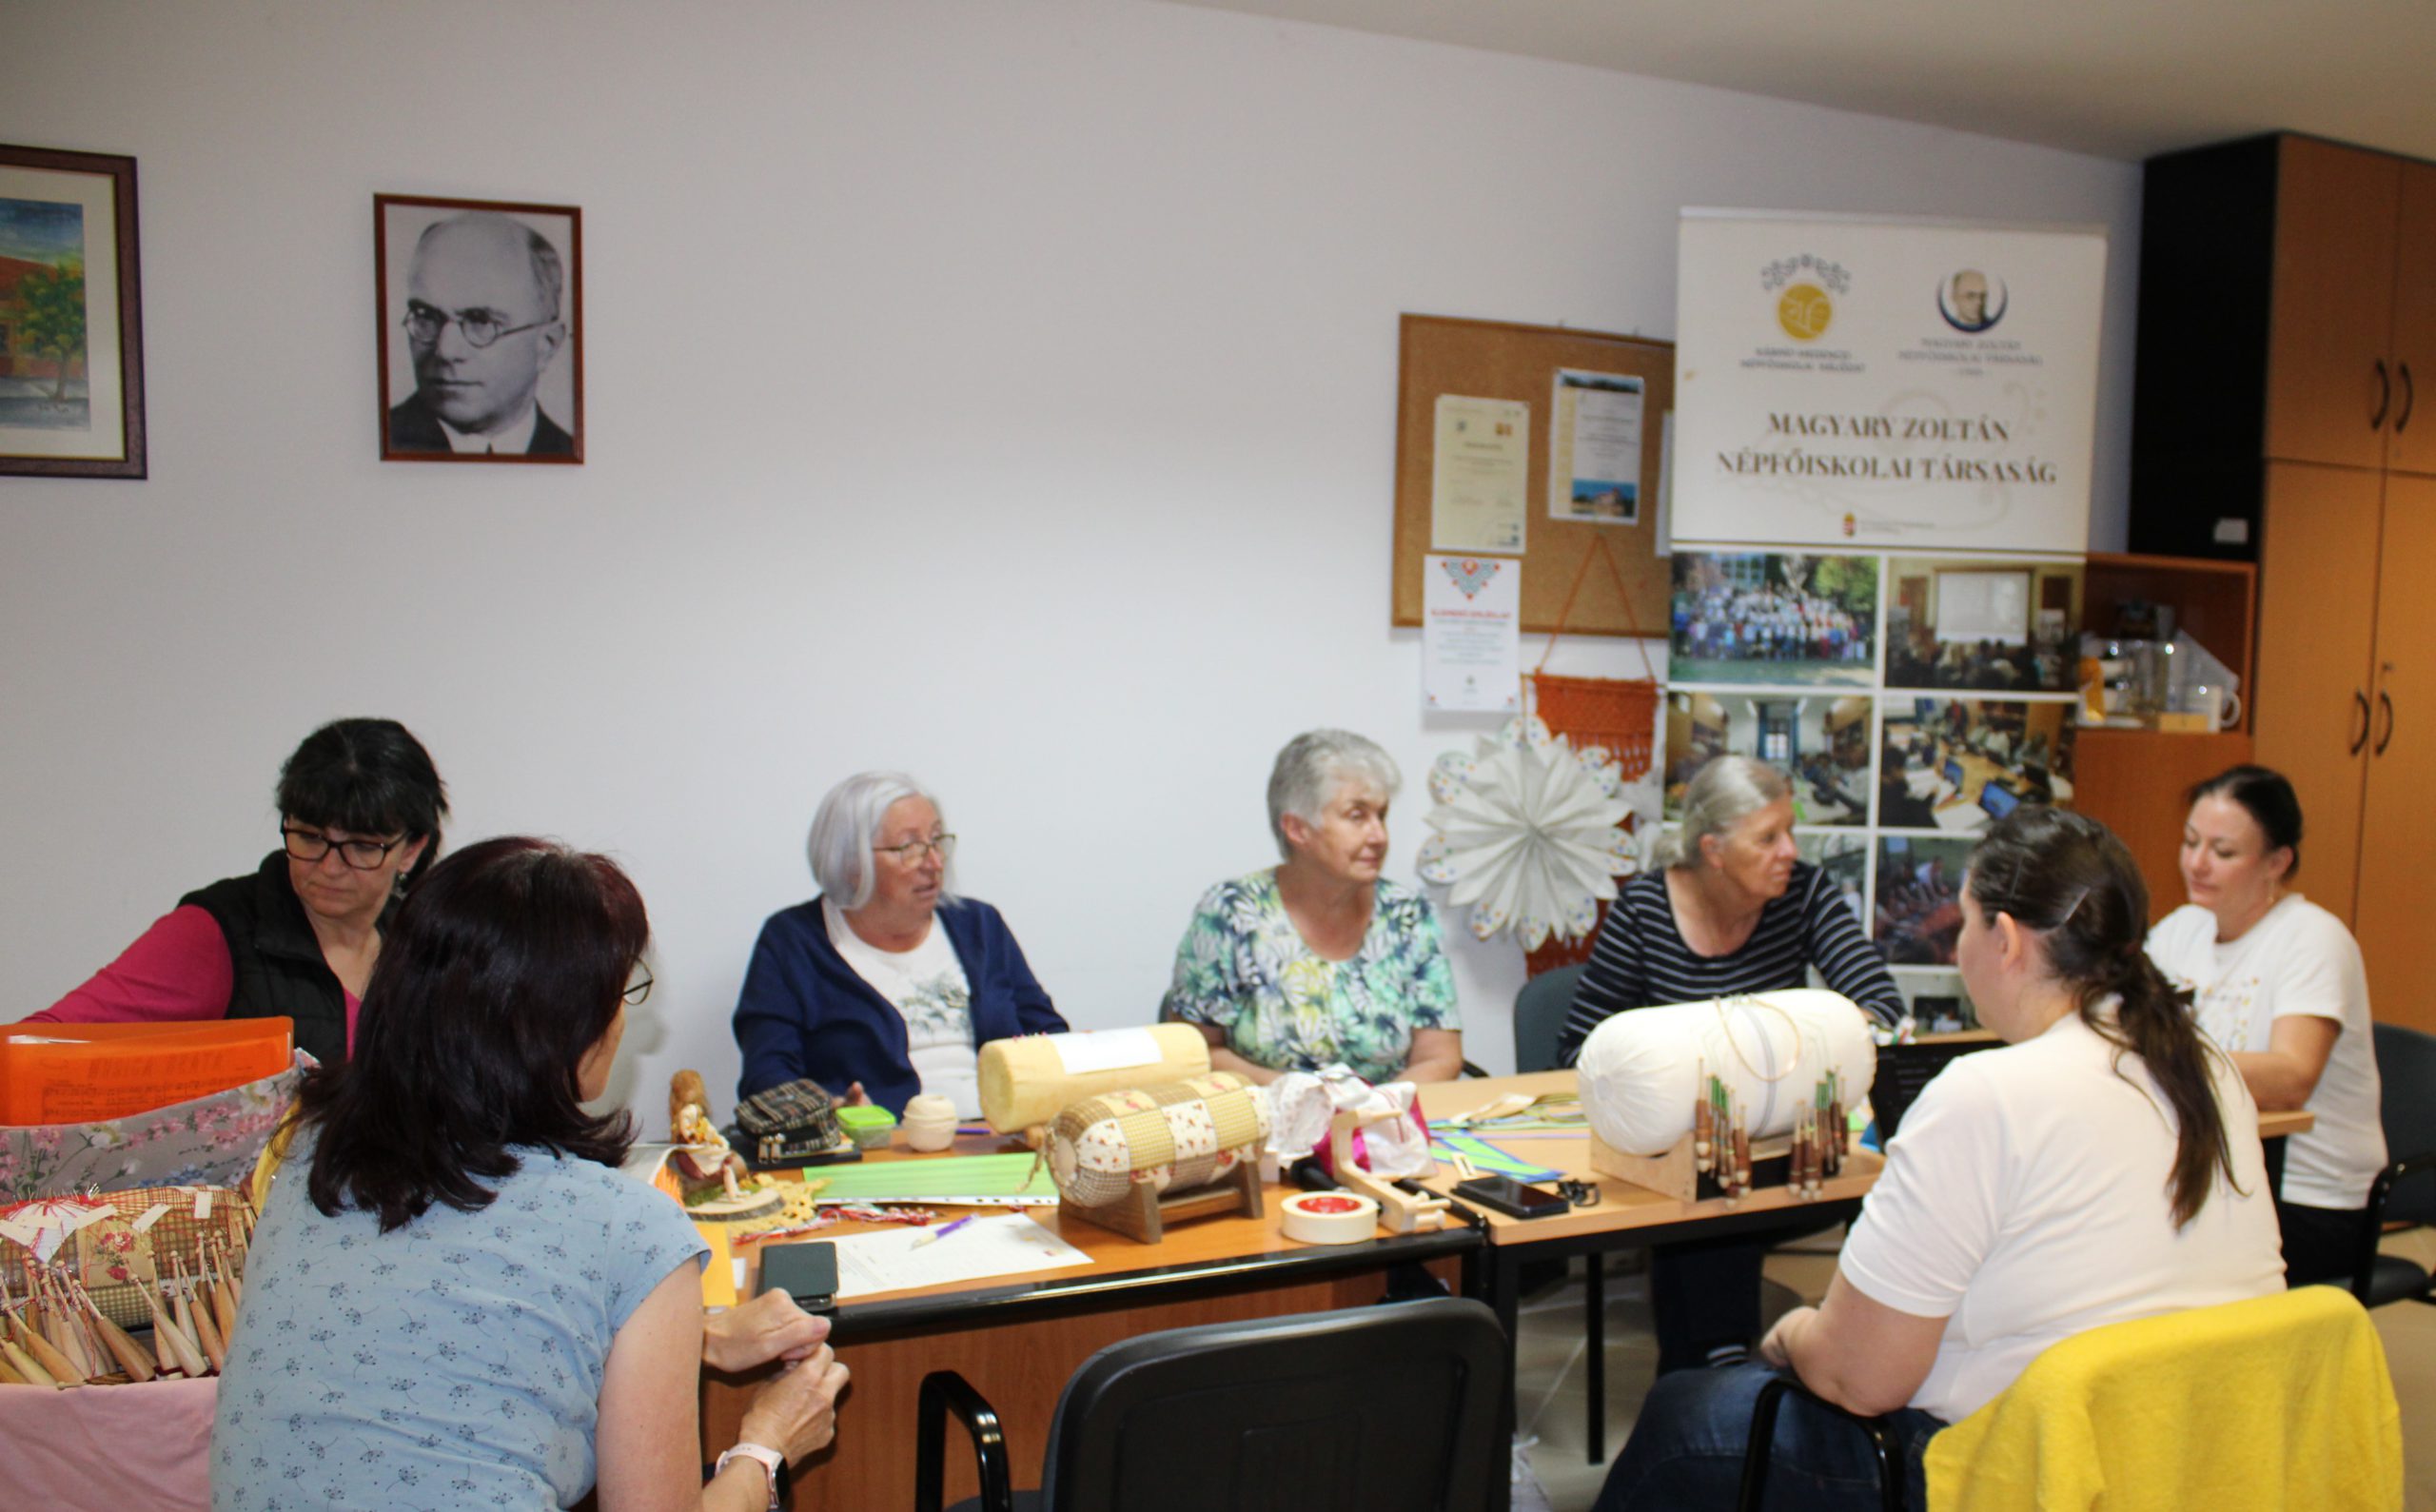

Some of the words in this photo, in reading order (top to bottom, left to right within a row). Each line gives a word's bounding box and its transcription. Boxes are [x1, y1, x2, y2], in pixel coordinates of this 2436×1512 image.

[1769, 411, 1894, 439] MAGYARY
[1903, 413, 2010, 442] ZOLTÁN
[1718, 446, 1913, 479] NÉPFŐISKOLAI
[1919, 454, 2057, 485] TÁRSASÁG
